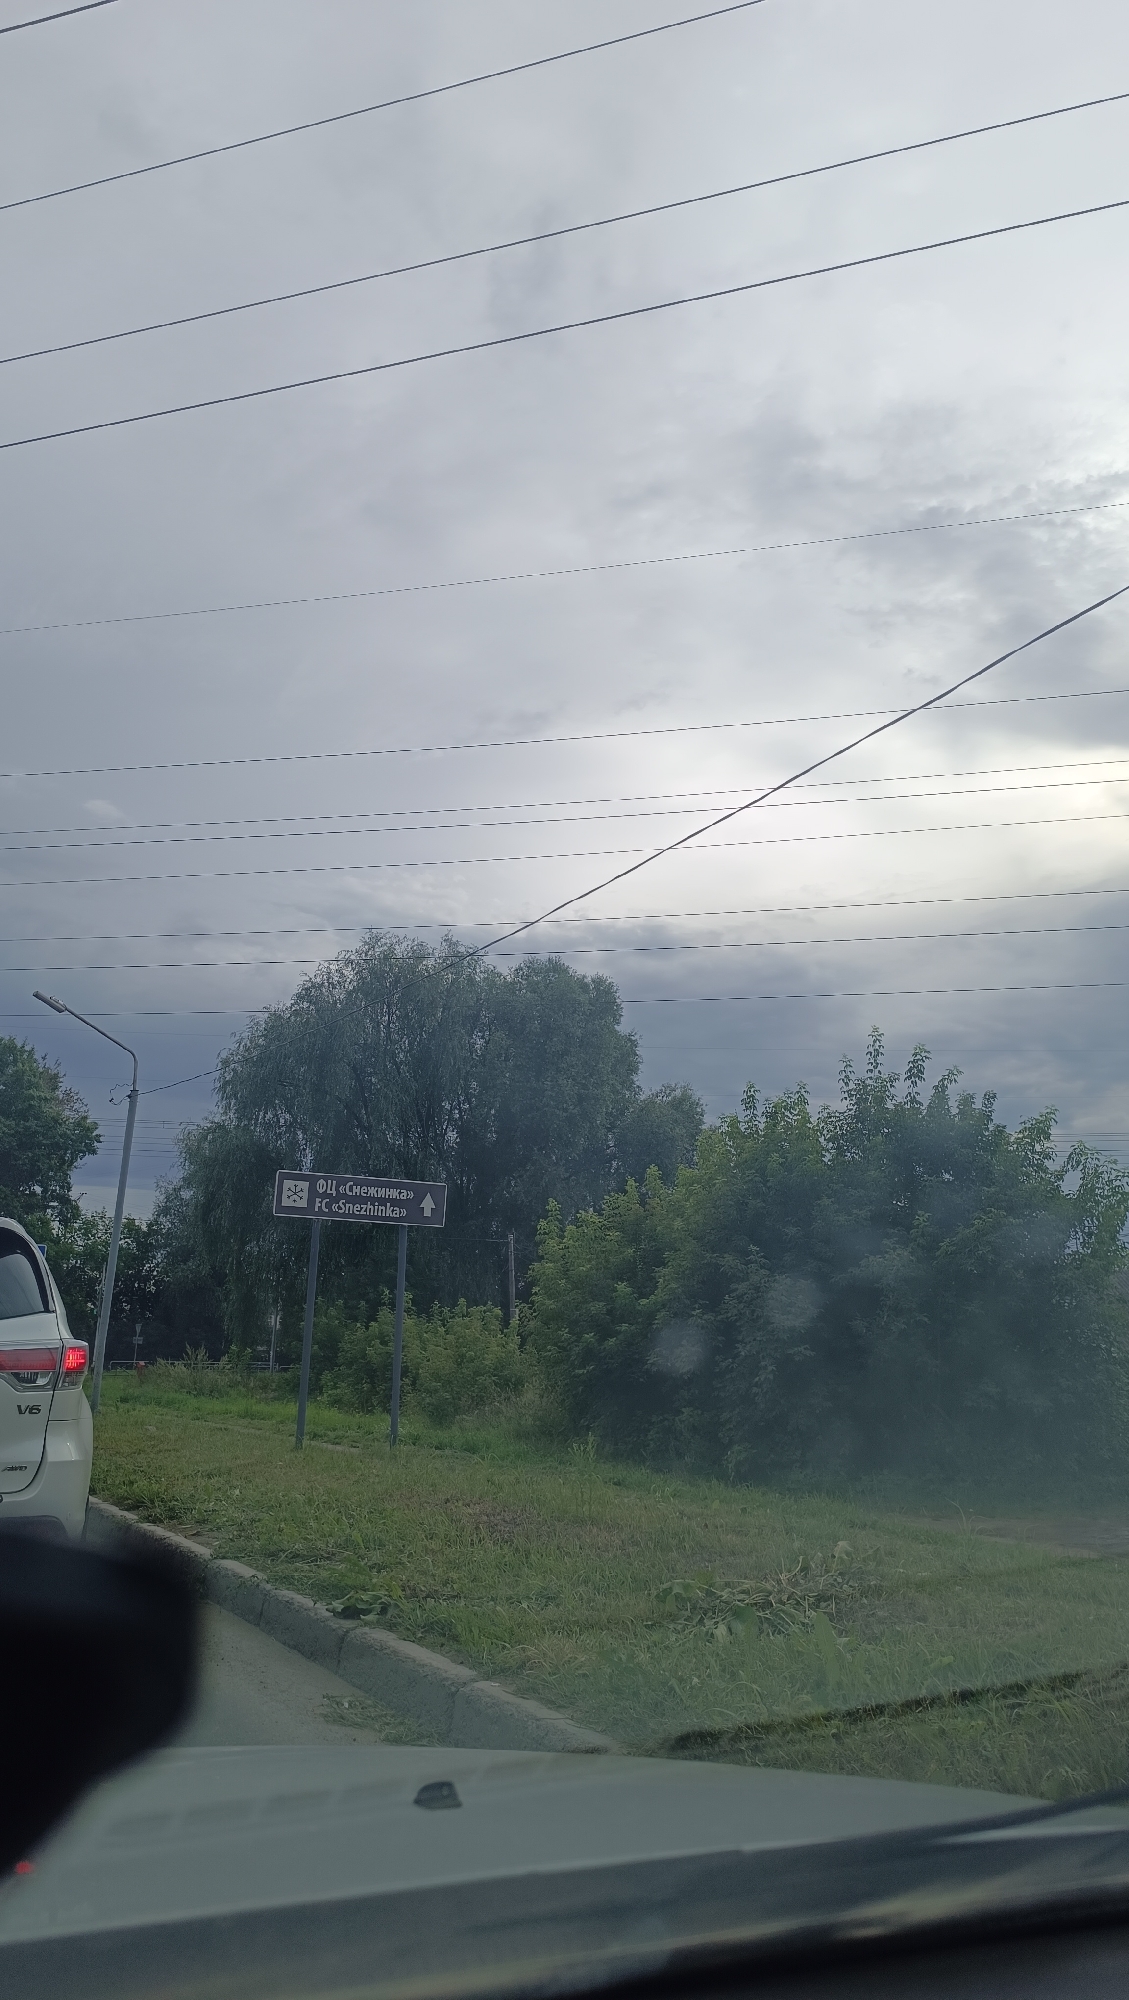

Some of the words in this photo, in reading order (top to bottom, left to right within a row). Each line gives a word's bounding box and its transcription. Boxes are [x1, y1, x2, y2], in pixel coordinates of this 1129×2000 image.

[316, 1179, 337, 1197] ФЦ
[339, 1182, 415, 1200] «Снежинка»
[314, 1198, 330, 1213] FC
[332, 1200, 407, 1217] «Snezhinka»
[16, 1404, 42, 1415] V6
